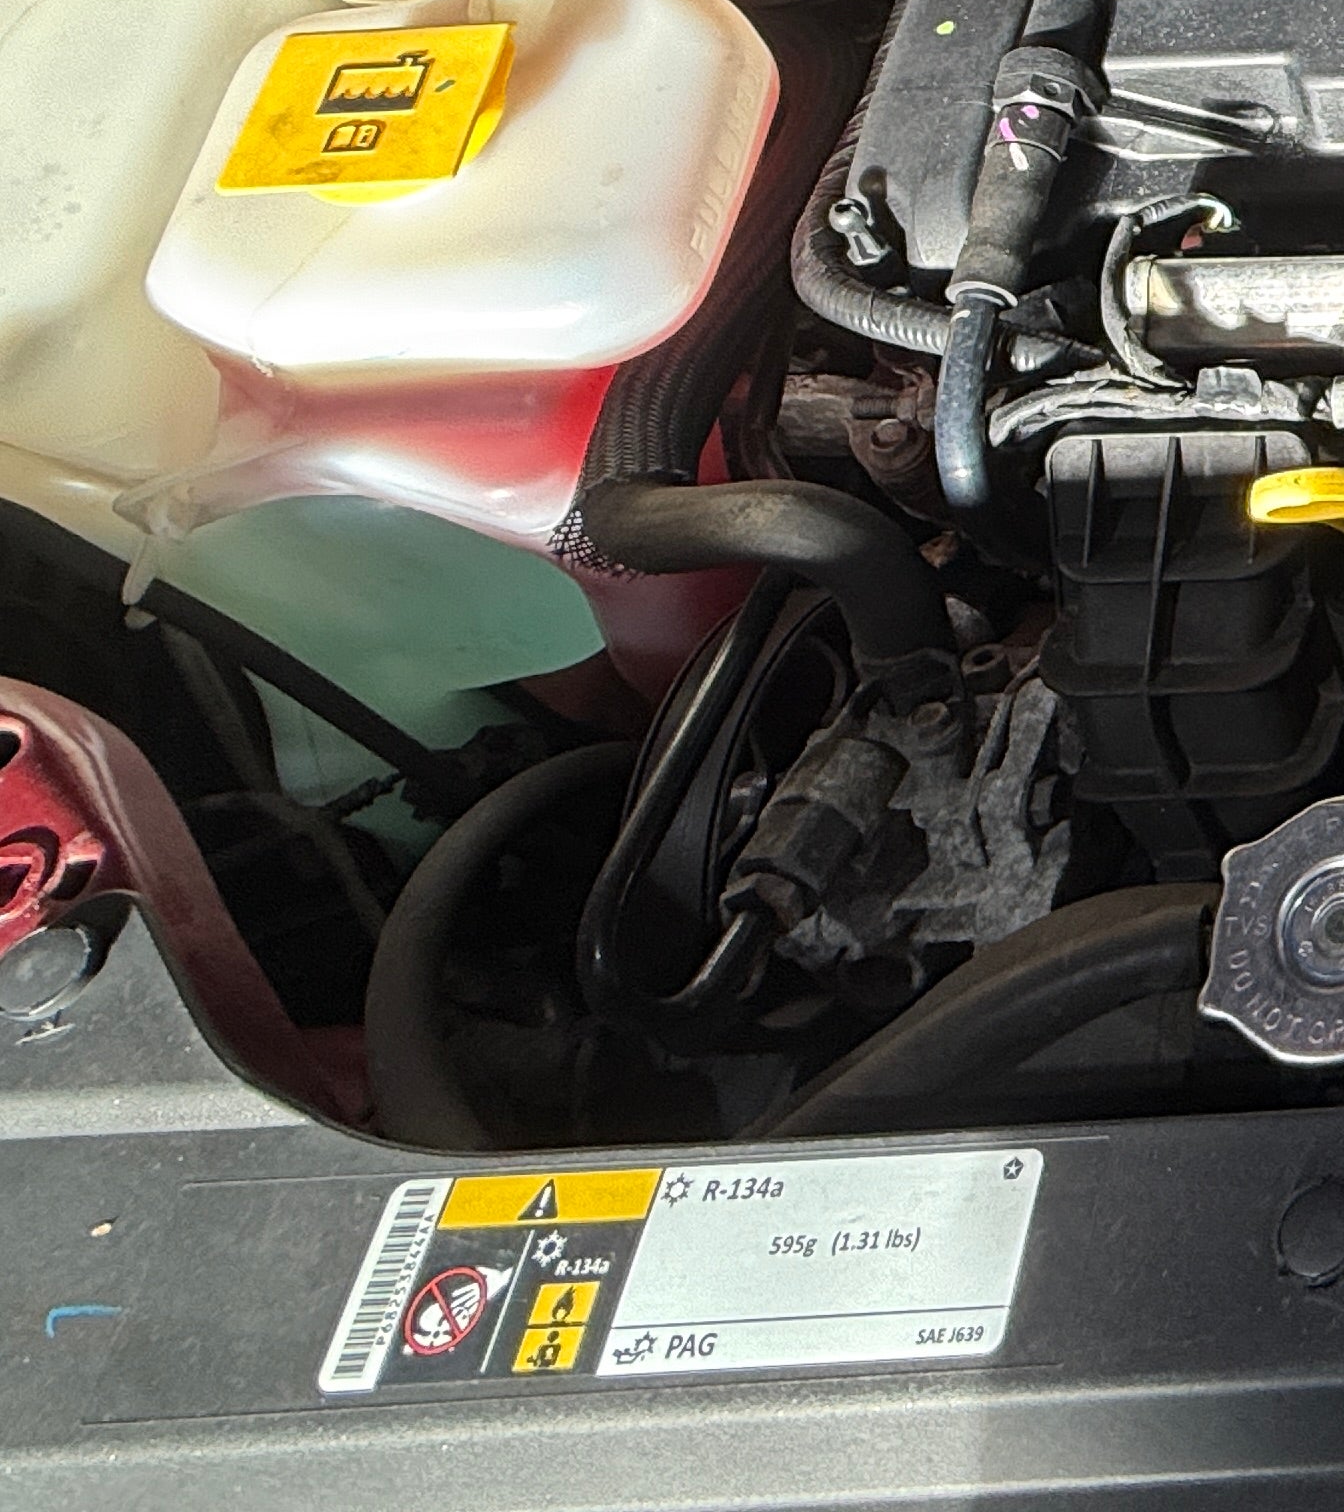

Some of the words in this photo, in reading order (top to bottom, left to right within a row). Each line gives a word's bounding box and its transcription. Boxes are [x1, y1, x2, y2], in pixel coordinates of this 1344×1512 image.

[1223, 915, 1270, 939] TVS
[701, 1176, 786, 1202] R-134a
[768, 1234, 819, 1258] 595g
[830, 1230, 879, 1257] (1.31
[885, 1226, 923, 1254] lbs)
[554, 1256, 611, 1277] R-134a
[664, 1332, 719, 1359] PAG
[914, 1328, 947, 1346] SAE
[948, 1324, 985, 1346] J639
